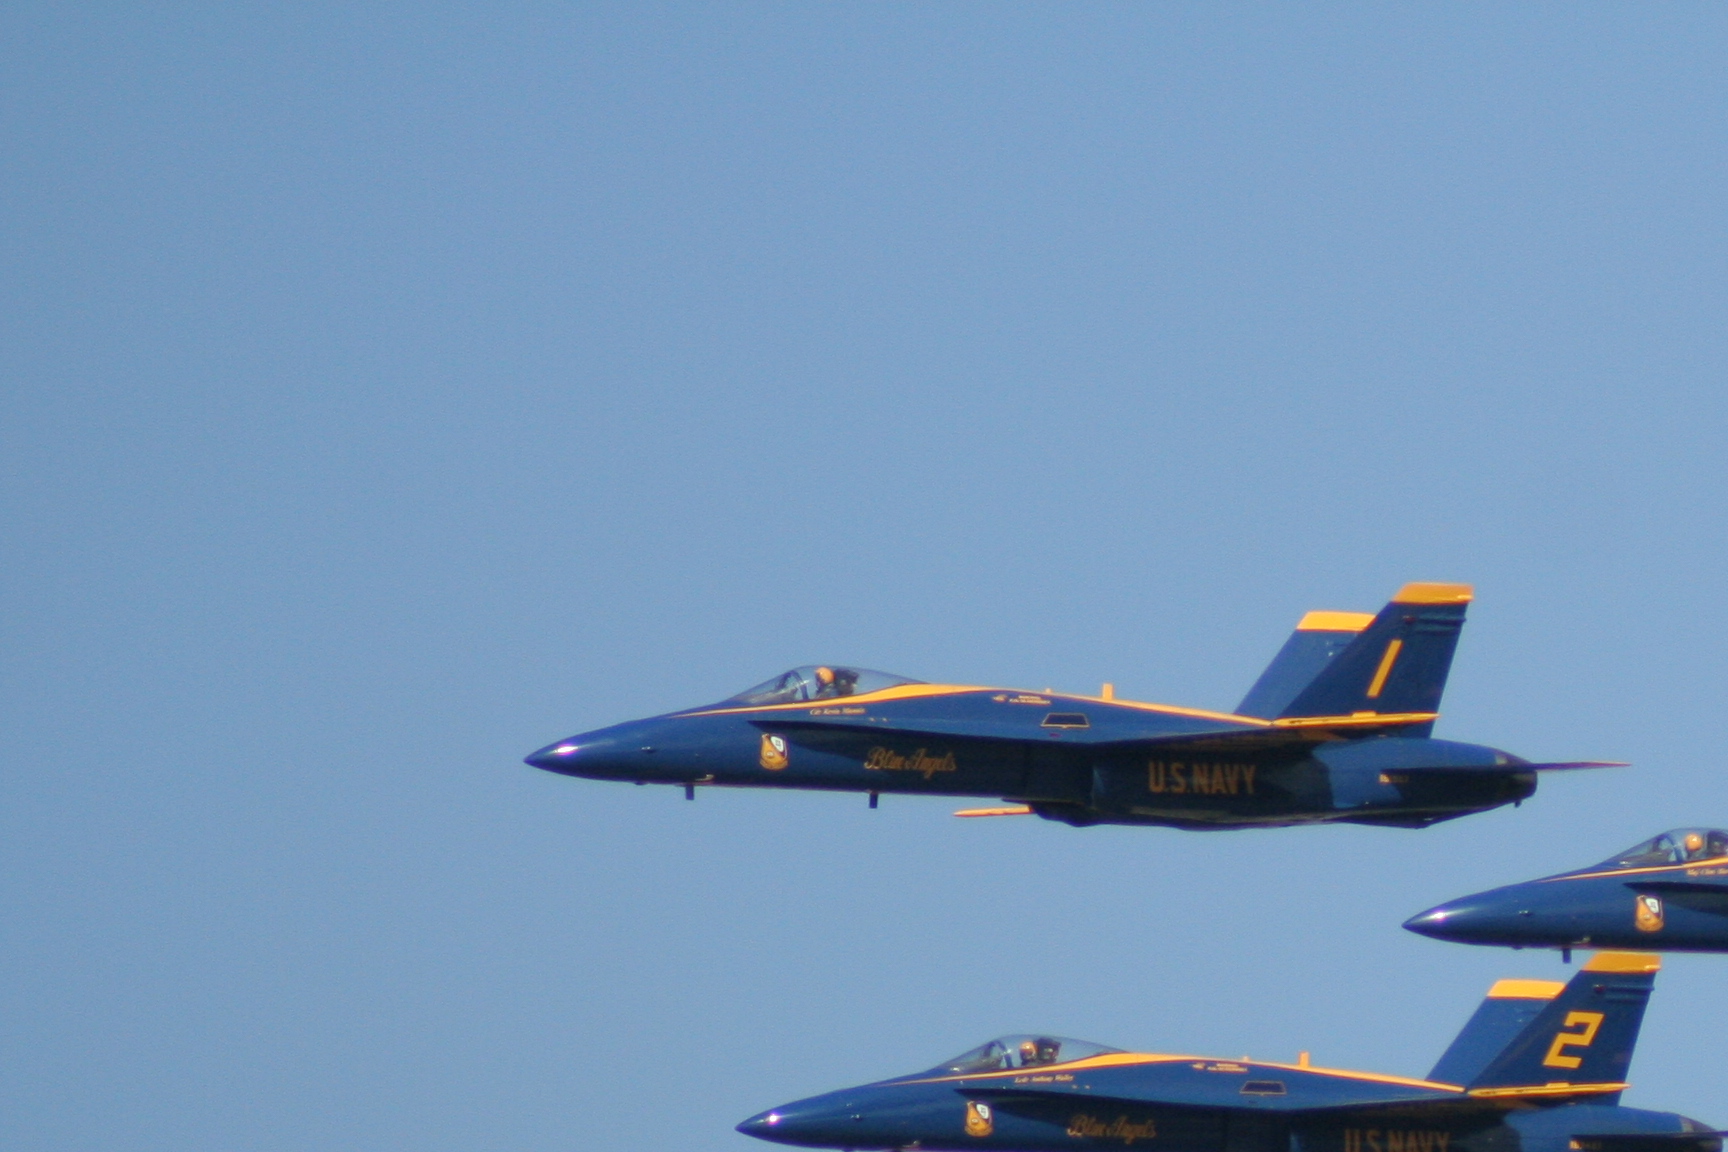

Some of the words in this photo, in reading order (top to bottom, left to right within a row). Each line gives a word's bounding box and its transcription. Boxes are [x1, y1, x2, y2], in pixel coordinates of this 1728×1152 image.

[1367, 639, 1402, 698] 1
[864, 746, 905, 770] Blue
[904, 748, 957, 780] Angels
[1192, 763, 1256, 795] NAVY
[1543, 1011, 1605, 1069] 2
[1066, 1114, 1107, 1137] Blue
[1106, 1114, 1157, 1145] Angels
